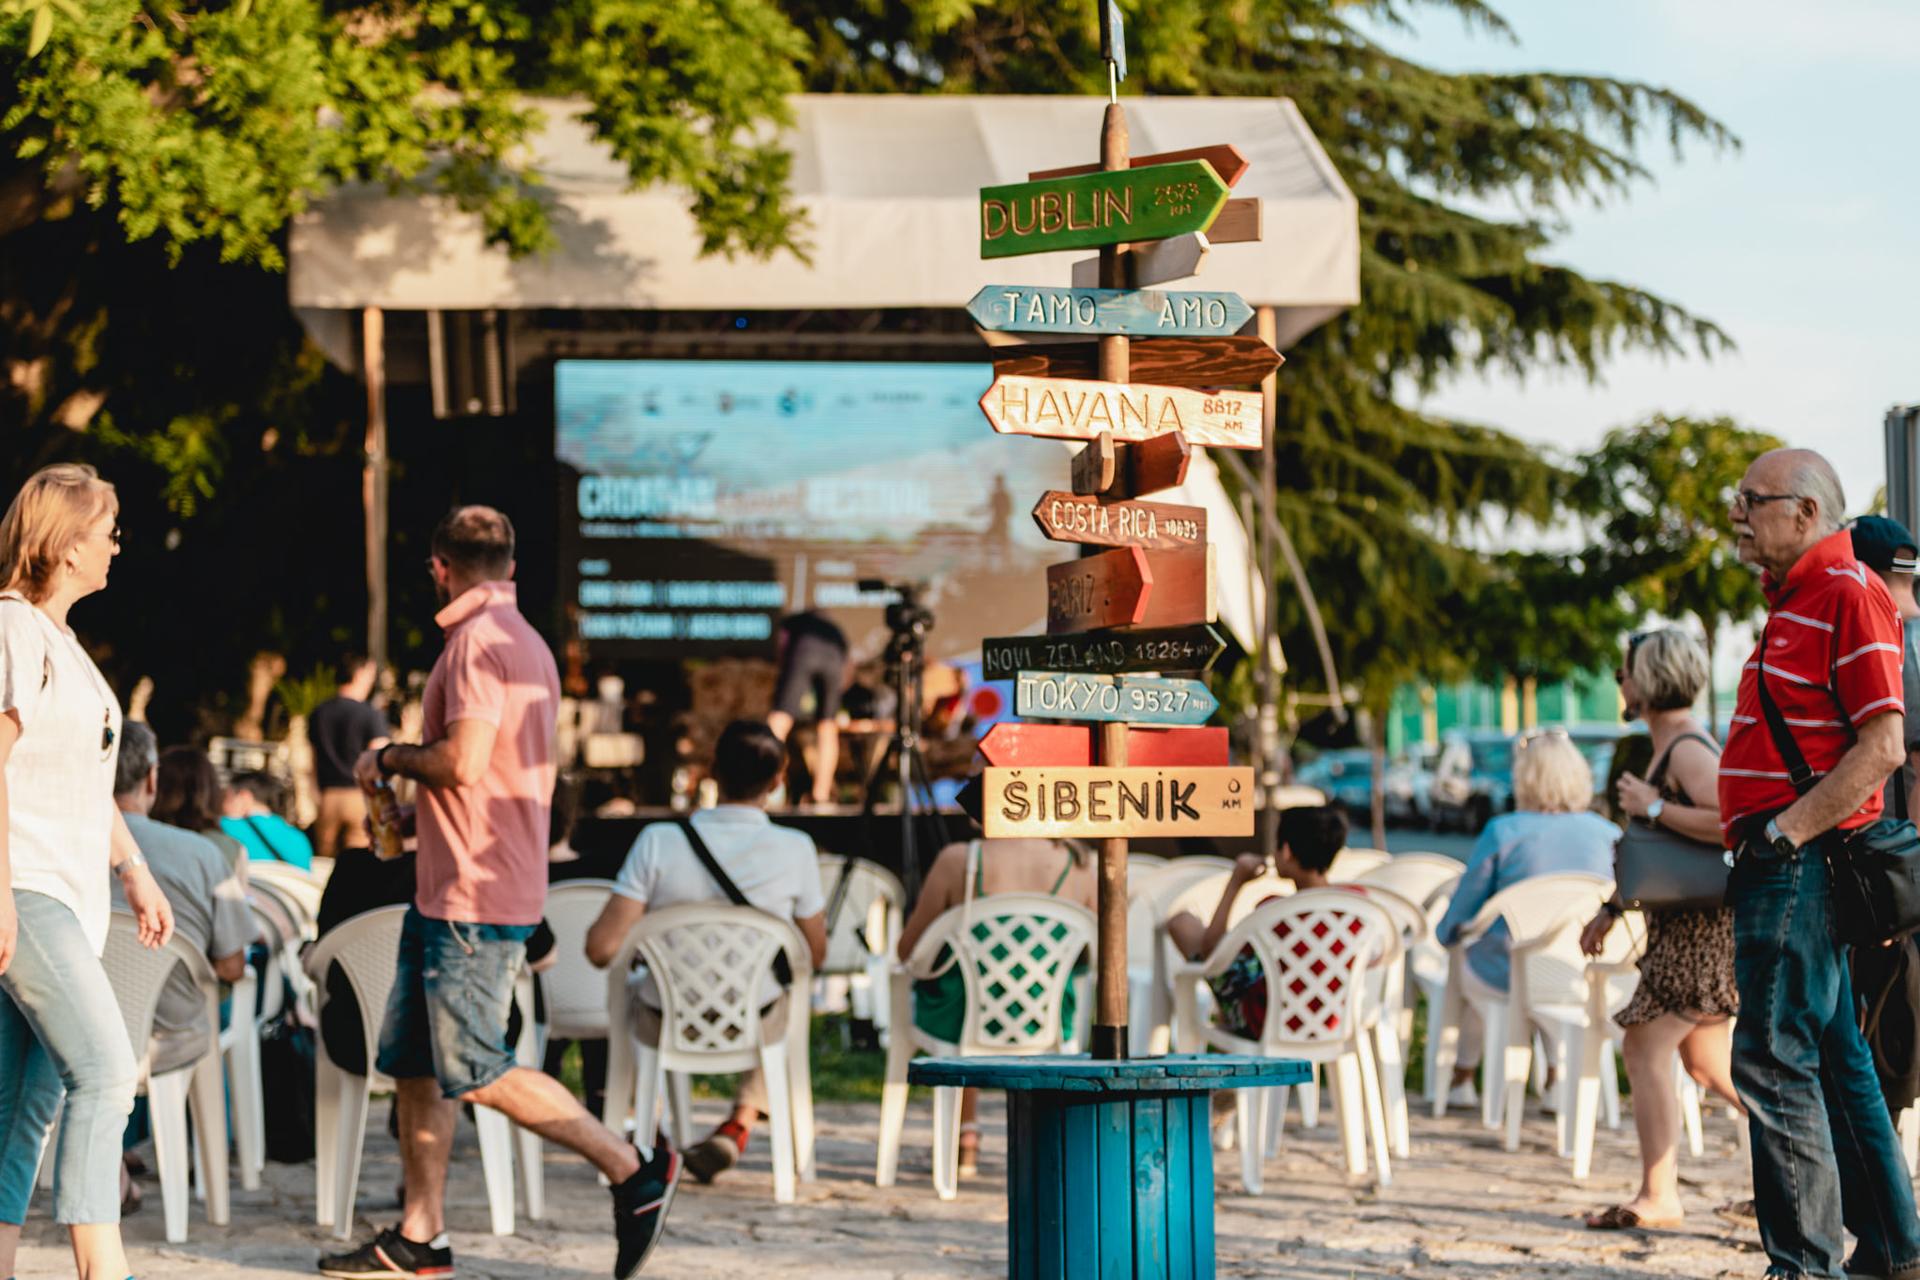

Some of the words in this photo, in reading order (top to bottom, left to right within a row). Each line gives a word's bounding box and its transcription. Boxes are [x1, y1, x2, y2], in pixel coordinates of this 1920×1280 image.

[983, 186, 1134, 240] DUBLIN
[1002, 291, 1097, 327] TAMO
[1158, 298, 1228, 328] AMO
[1001, 384, 1184, 432] HAVANA
[1203, 399, 1242, 416] 8817
[1224, 420, 1243, 431] KM
[1051, 500, 1110, 534] COSTA
[1119, 506, 1158, 539] RICA
[986, 646, 1032, 671] NOVI
[1045, 641, 1125, 669] ZELAND
[1135, 641, 1195, 660] 18284
[1021, 679, 1121, 713] TOKYO
[1131, 689, 1190, 713] 9527
[1222, 799, 1242, 810] KM
